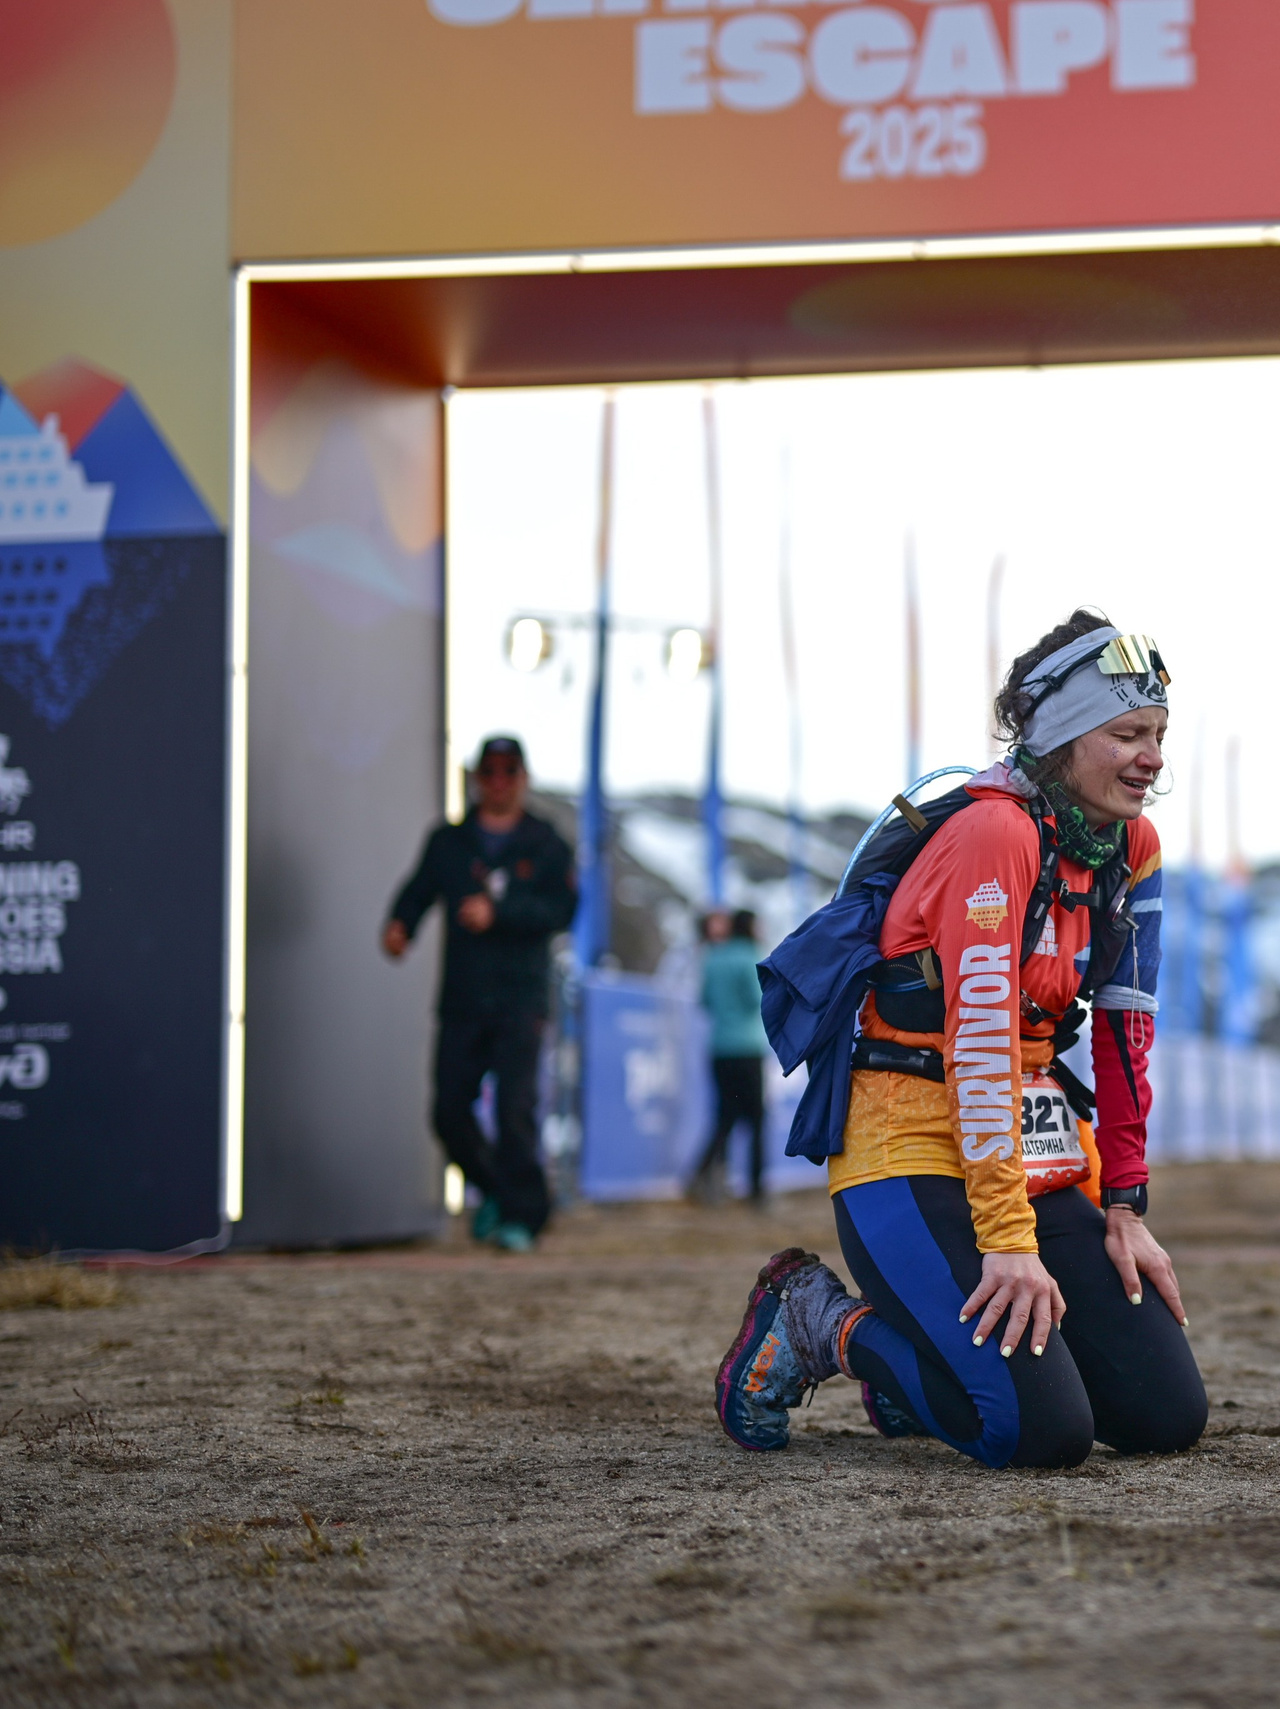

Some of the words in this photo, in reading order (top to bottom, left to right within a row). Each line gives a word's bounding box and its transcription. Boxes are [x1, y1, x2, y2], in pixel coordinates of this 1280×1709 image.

[633, 0, 1197, 114] ESCAPE
[838, 104, 987, 181] 2025
[953, 943, 1015, 1162] SURVIVOR
[743, 1331, 781, 1392] HOKA
